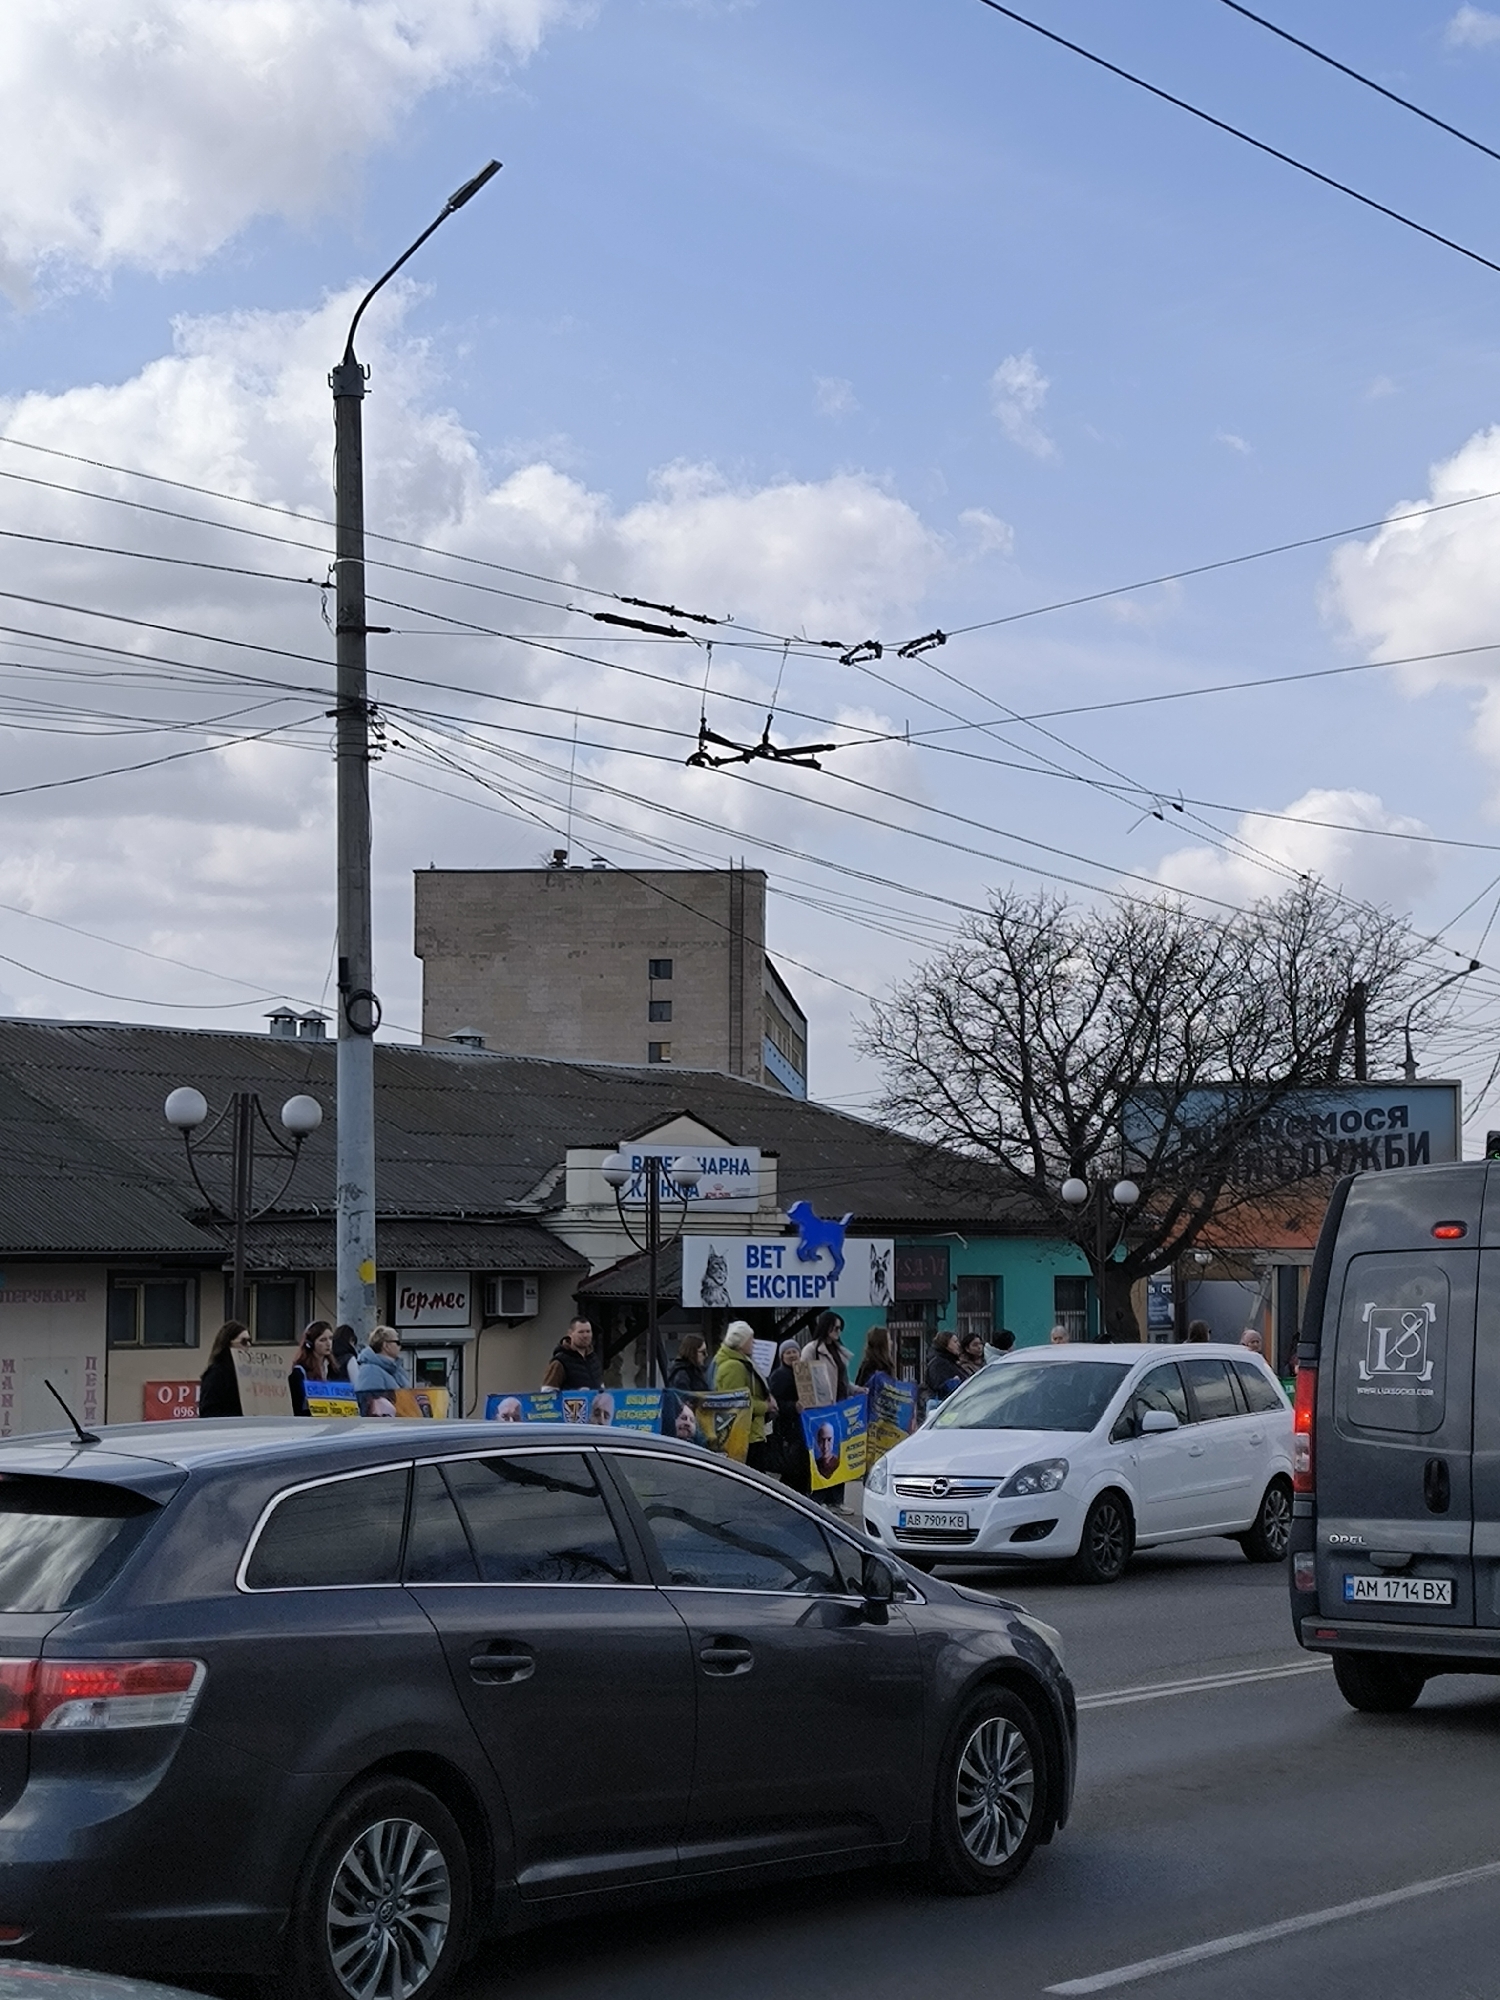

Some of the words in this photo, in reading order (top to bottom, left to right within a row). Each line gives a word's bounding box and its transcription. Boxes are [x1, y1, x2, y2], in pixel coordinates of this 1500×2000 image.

[631, 1155, 750, 1176] ВЕНАРНА
[746, 1245, 786, 1269] ВЕТ
[746, 1275, 839, 1299] ЕКСПЕРТ
[400, 1286, 466, 1320] Гермес
[1329, 1534, 1367, 1546] OPEL
[1355, 1580, 1378, 1598] AM
[1383, 1581, 1419, 1600] 1714
[1423, 1582, 1447, 1602] BX
